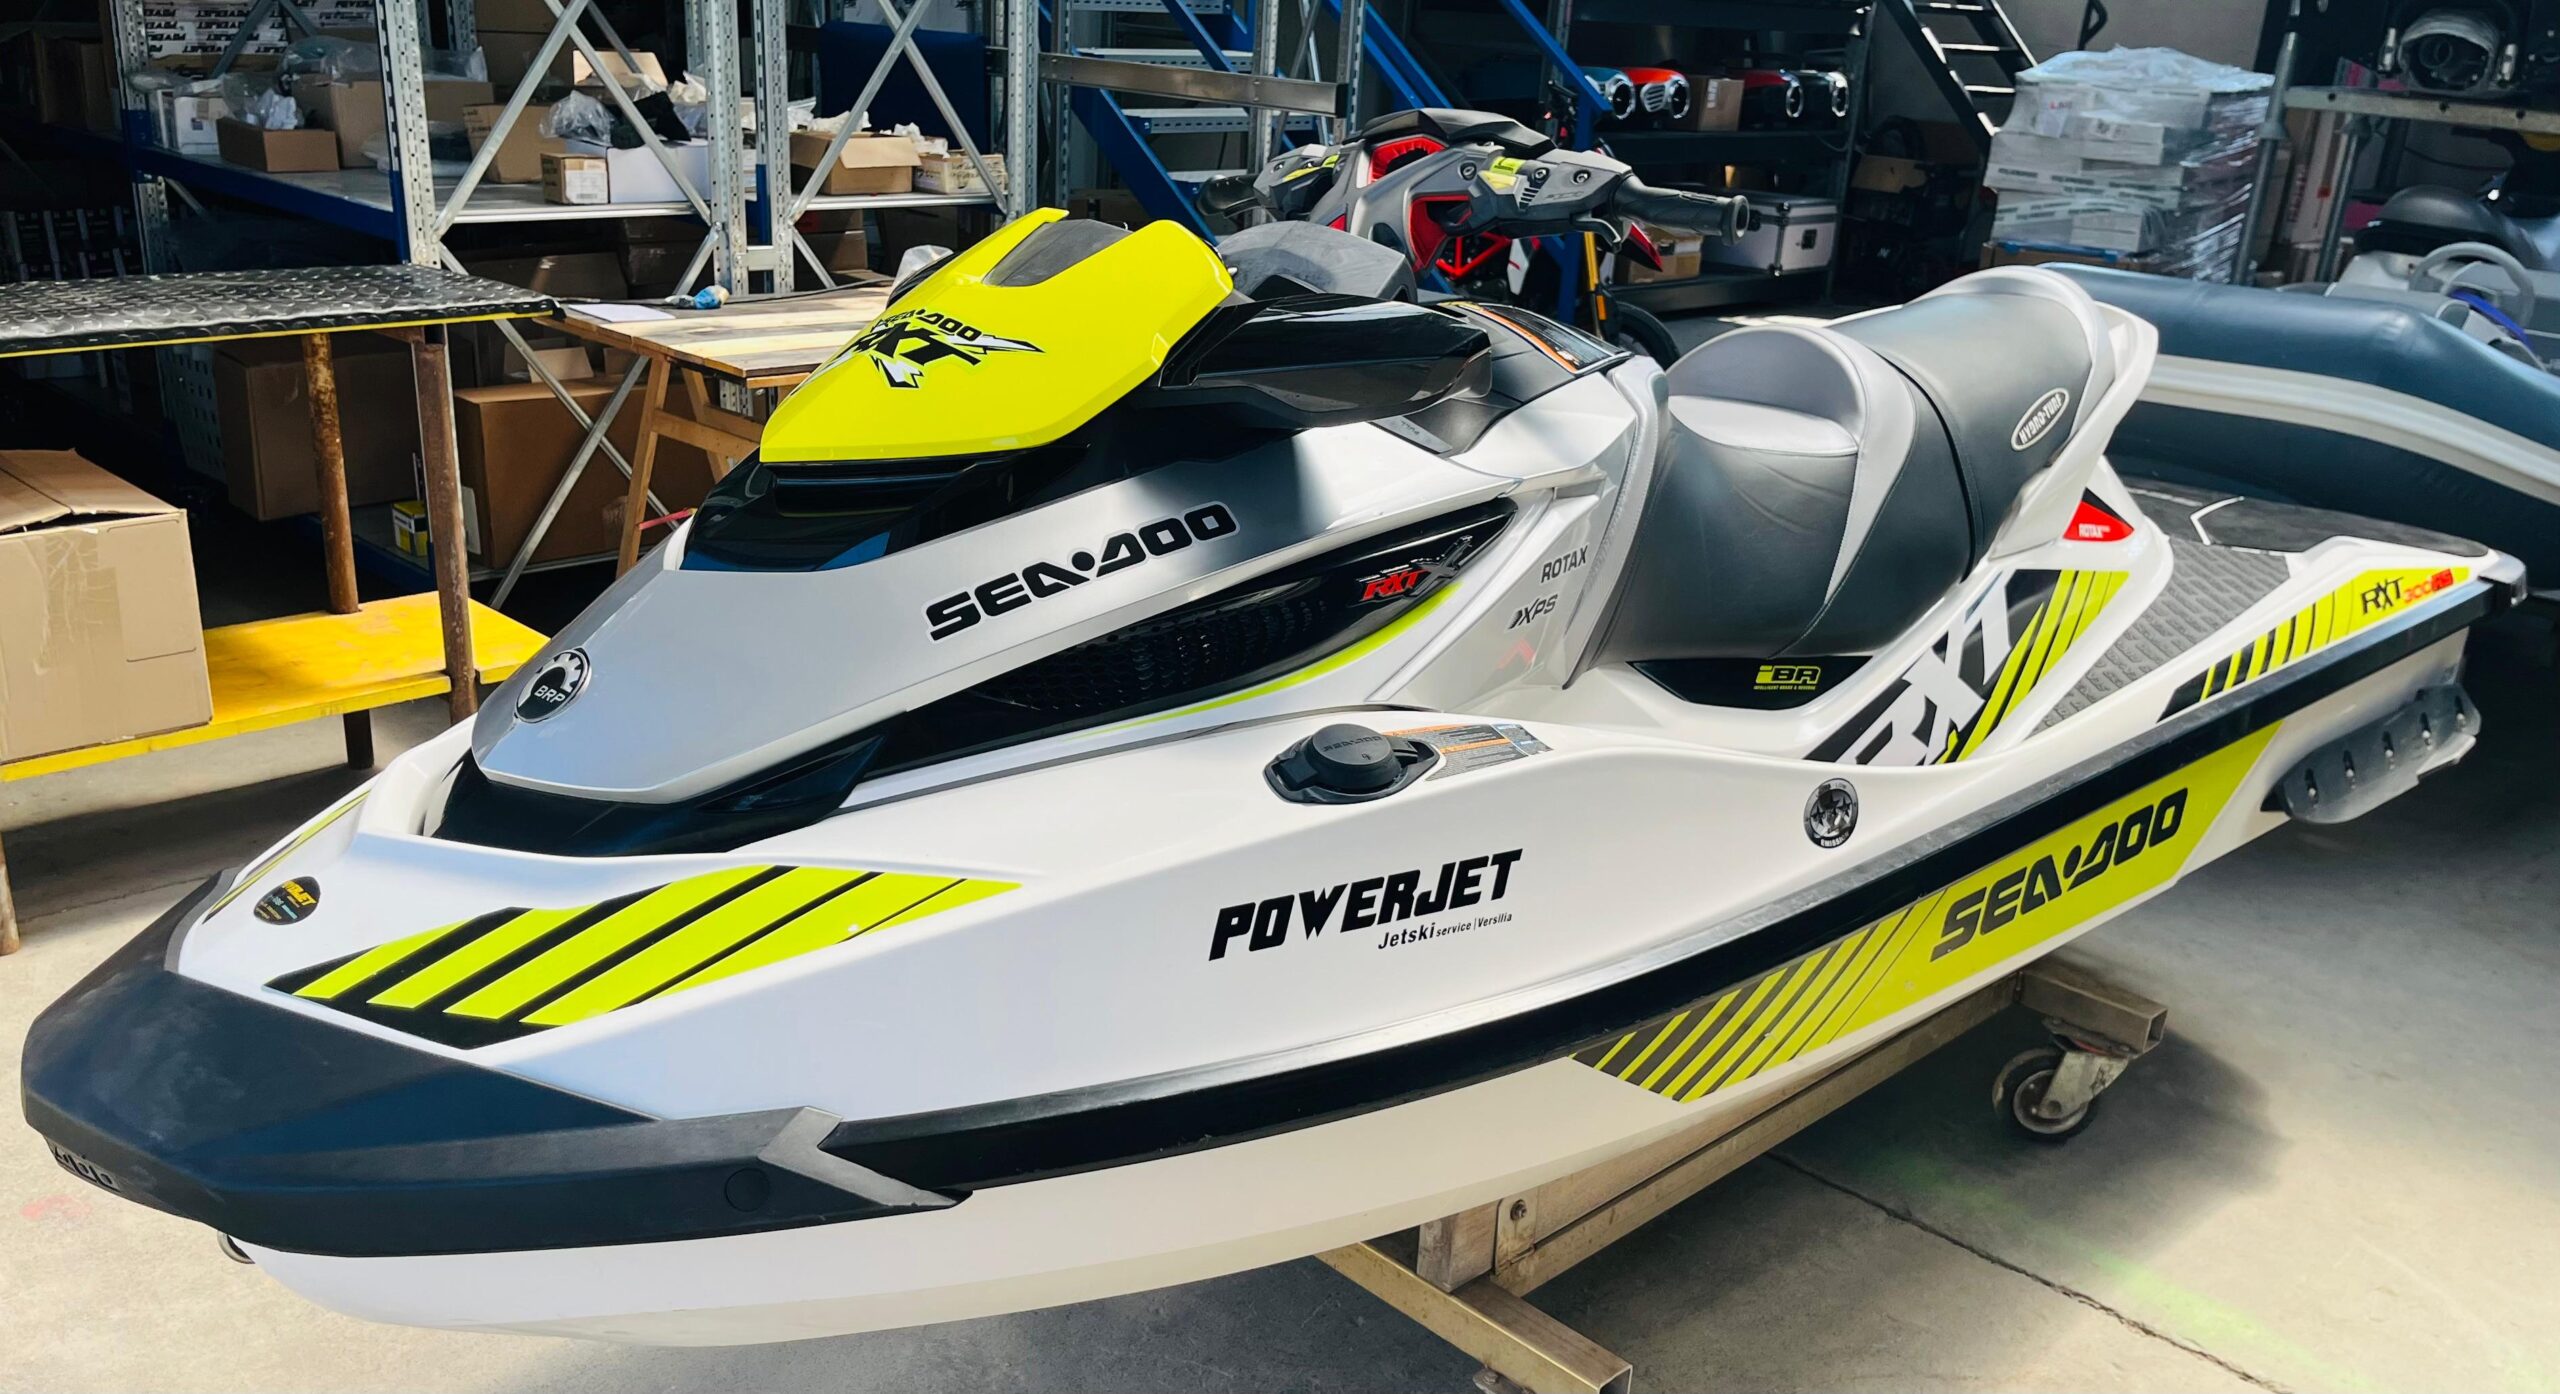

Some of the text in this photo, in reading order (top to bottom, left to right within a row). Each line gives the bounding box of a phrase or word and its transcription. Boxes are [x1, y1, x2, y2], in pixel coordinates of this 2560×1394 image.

[1541, 545, 1588, 583] ROTAX
[2361, 576, 2404, 614] RXT
[1208, 848, 1523, 962] POWERJET
[1378, 911, 1513, 950] Jetski service Versilia
